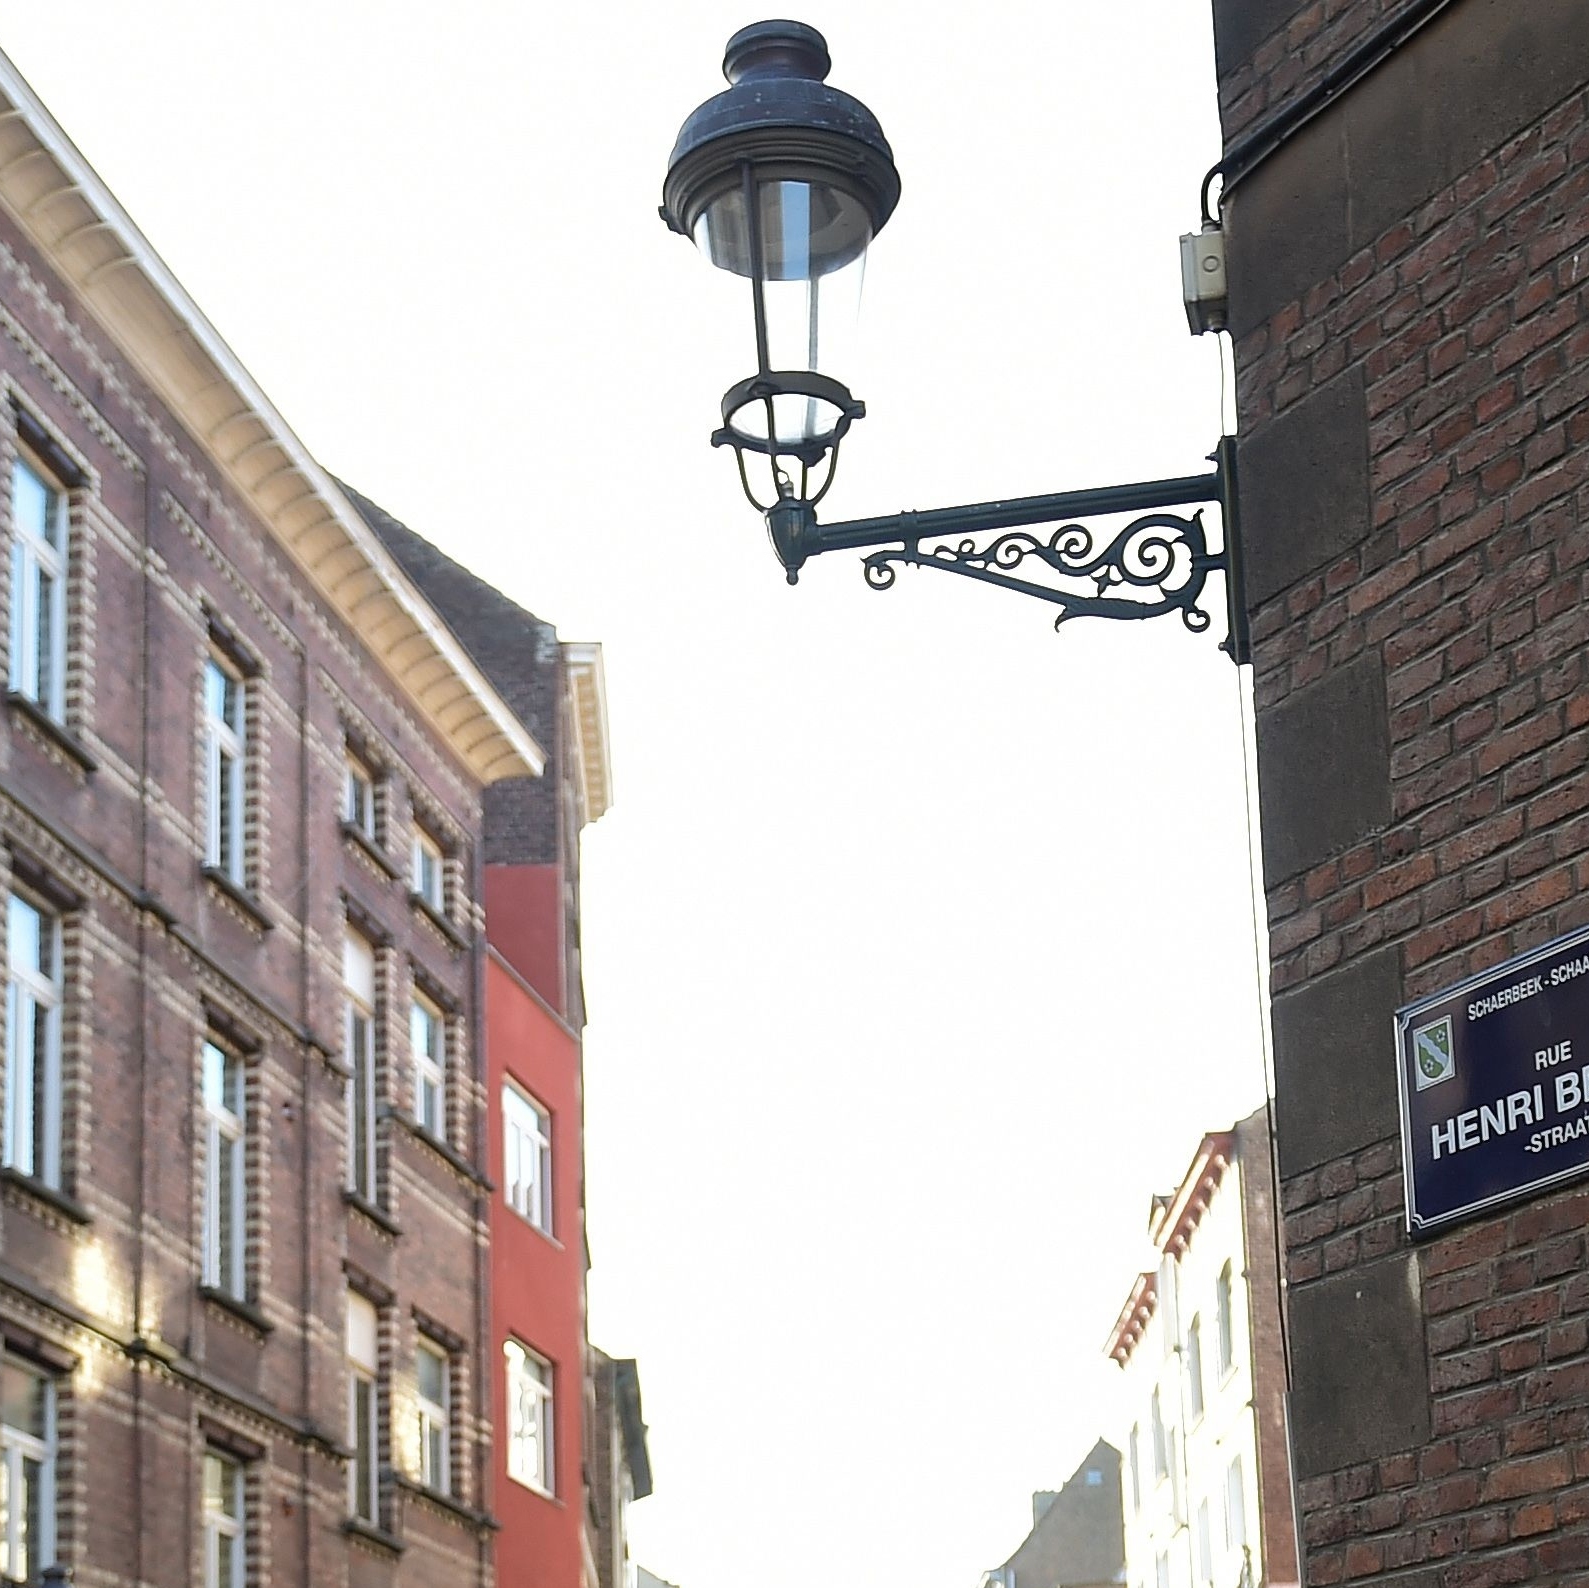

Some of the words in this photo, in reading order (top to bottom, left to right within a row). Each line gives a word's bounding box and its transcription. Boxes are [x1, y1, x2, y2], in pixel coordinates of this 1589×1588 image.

[1468, 975, 1543, 1022] SCHAERBEEK
[1534, 1040, 1572, 1072] RUE
[1430, 1084, 1544, 1161] HENRI
